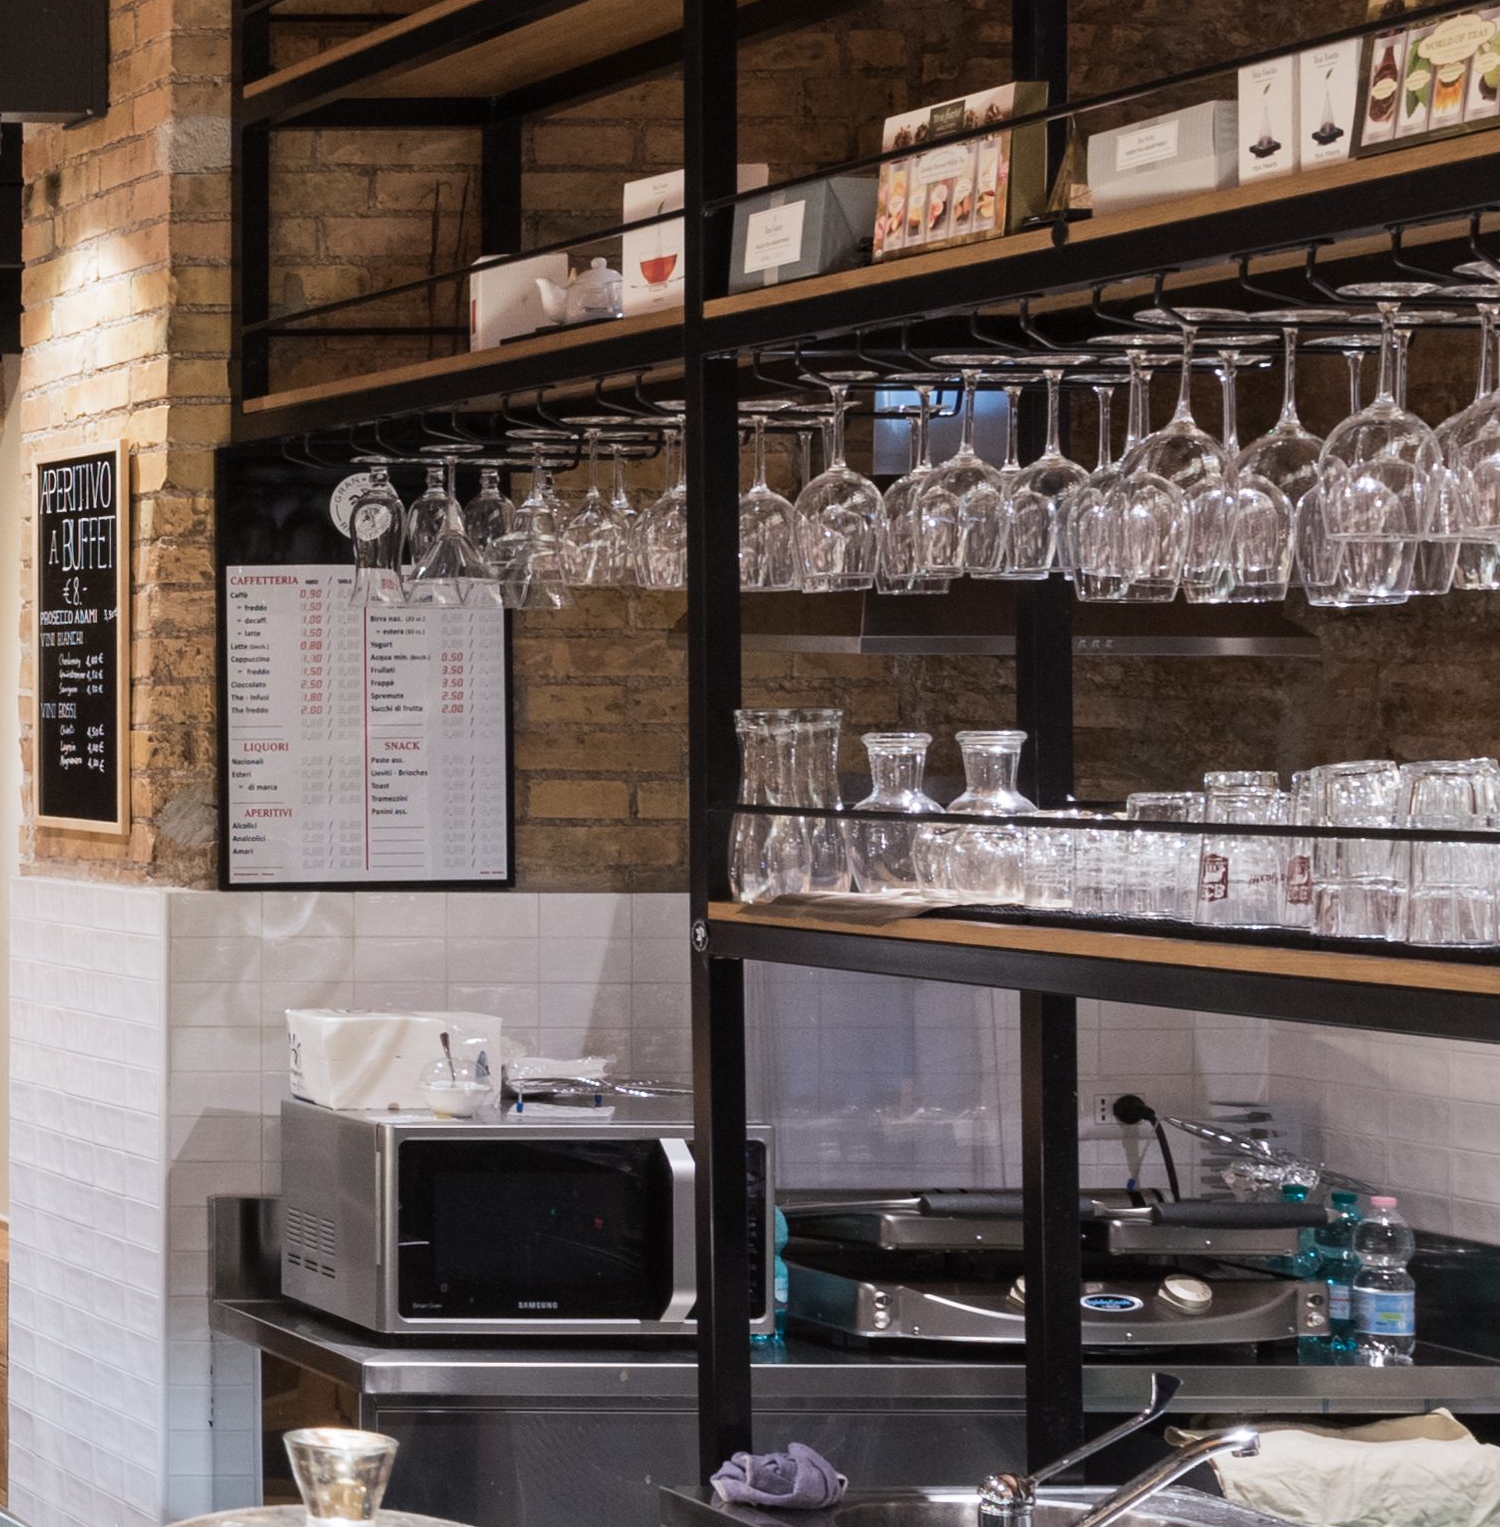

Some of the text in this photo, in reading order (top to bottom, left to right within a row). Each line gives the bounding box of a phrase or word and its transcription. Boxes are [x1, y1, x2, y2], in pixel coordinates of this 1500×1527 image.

[1425, 28, 1489, 51] WORLD OF TEAS
[1313, 54, 1324, 64] Tea
[1252, 164, 1262, 172] TEA
[39, 461, 113, 515] APERITIVO
[334, 476, 360, 503] GRAN
[48, 515, 116, 572] A BUFFET
[230, 575, 299, 586] CAFFETTERIA
[244, 604, 268, 612] freddo
[40, 608, 98, 626] PROSECCO ADAMI
[370, 615, 387, 623] Birra
[40, 632, 56, 647] VINI
[230, 643, 248, 651] Latte
[370, 641, 393, 650] Yogurt
[230, 656, 271, 664] Cappuccino
[370, 654, 392, 662] Acqua
[441, 651, 463, 662] 0.50
[246, 668, 270, 676] freddo
[370, 665, 463, 675] Frullati 3.50
[441, 678, 463, 688] 3.50
[370, 691, 463, 701] Spremute 2.50
[40, 702, 78, 719] VINI ROSSI
[245, 706, 269, 714] freddo
[370, 705, 393, 713] Succhi
[403, 705, 423, 713] frutta
[441, 704, 464, 714] 2.00
[243, 742, 290, 753] LIQUORI
[384, 741, 421, 751] SNACK
[231, 758, 264, 766] Nazionali
[371, 756, 390, 764] Paste
[398, 769, 428, 777] Brioches
[244, 808, 293, 818] APERITIVI
[232, 822, 258, 830] Alcolici
[518, 1301, 558, 1309] SAMSUNG
